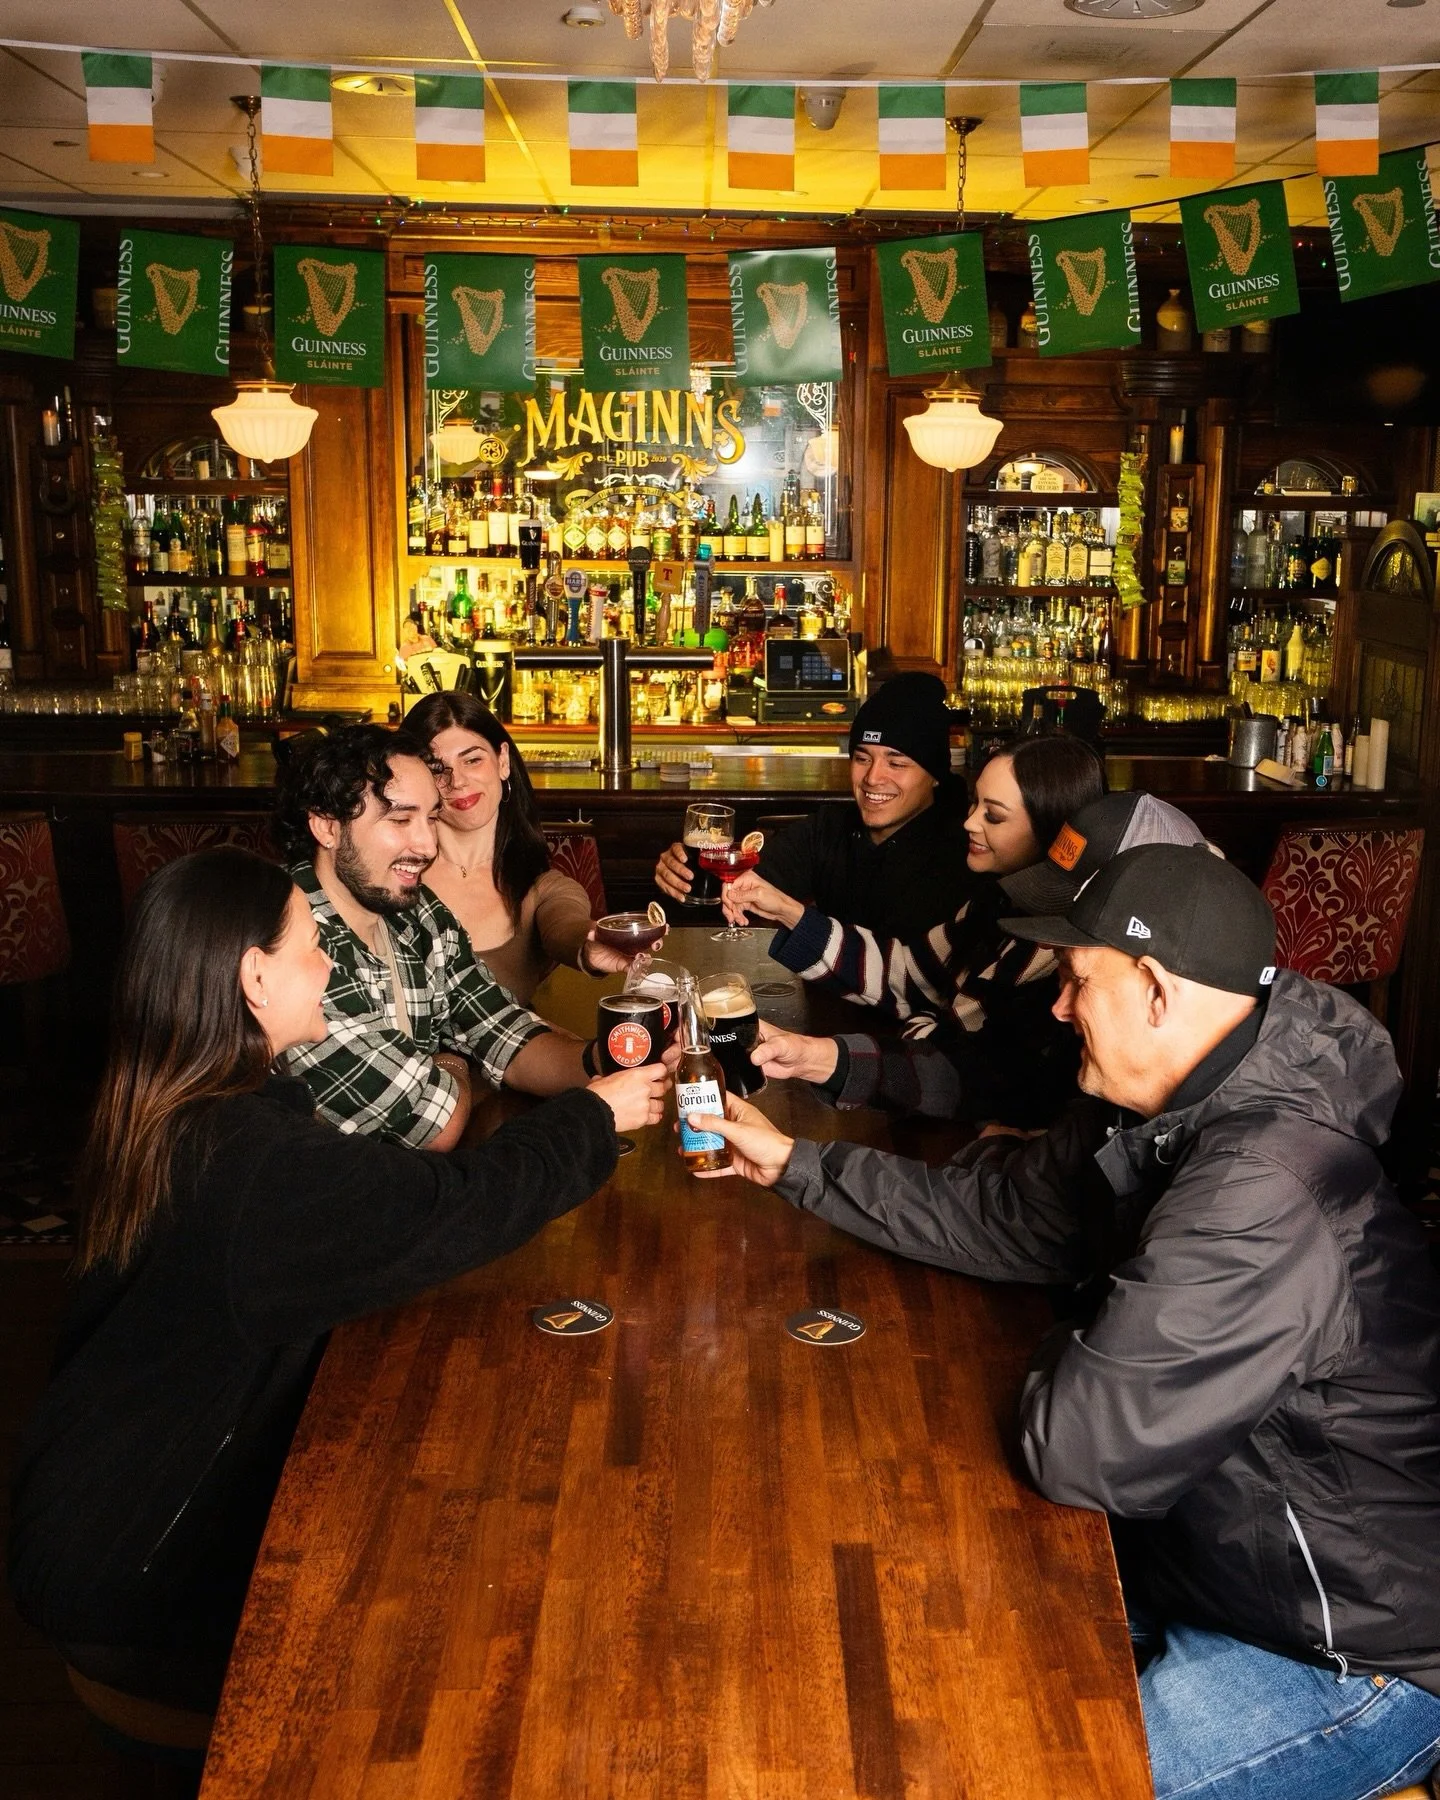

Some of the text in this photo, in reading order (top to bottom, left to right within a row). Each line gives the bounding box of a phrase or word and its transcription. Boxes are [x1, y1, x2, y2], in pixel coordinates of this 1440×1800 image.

[1324, 180, 1351, 291] GUINNESS
[1028, 234, 1050, 346] GUINNESS
[1208, 274, 1280, 299] GUINNESS
[117, 239, 134, 354] GUINNESS
[1225, 296, 1269, 311] SLÁINTE
[424, 264, 440, 378] GUINNESS
[729, 263, 749, 377] GUINNESS
[0, 322, 41, 338] LÁINTE
[902, 325, 973, 344] GUINNESS
[291, 337, 367, 356] GUINNESS
[600, 346, 673, 361] GUINNESS
[918, 346, 962, 358] SLÁINTE
[307, 358, 353, 371] SLÁINTE
[615, 365, 660, 376] SLÁINTE
[516, 388, 746, 467] MAGINN'S
[615, 450, 649, 468] PUB
[650, 455, 668, 463] 2020
[662, 568, 672, 581] T
[697, 840, 731, 851] GUINNESS
[708, 1032, 738, 1044] NNESS
[616, 1055, 643, 1064] RED ALE
[678, 1093, 718, 1109] Corona
[571, 1300, 607, 1322] GUINNESS
[817, 1310, 861, 1331] GUINNESS
